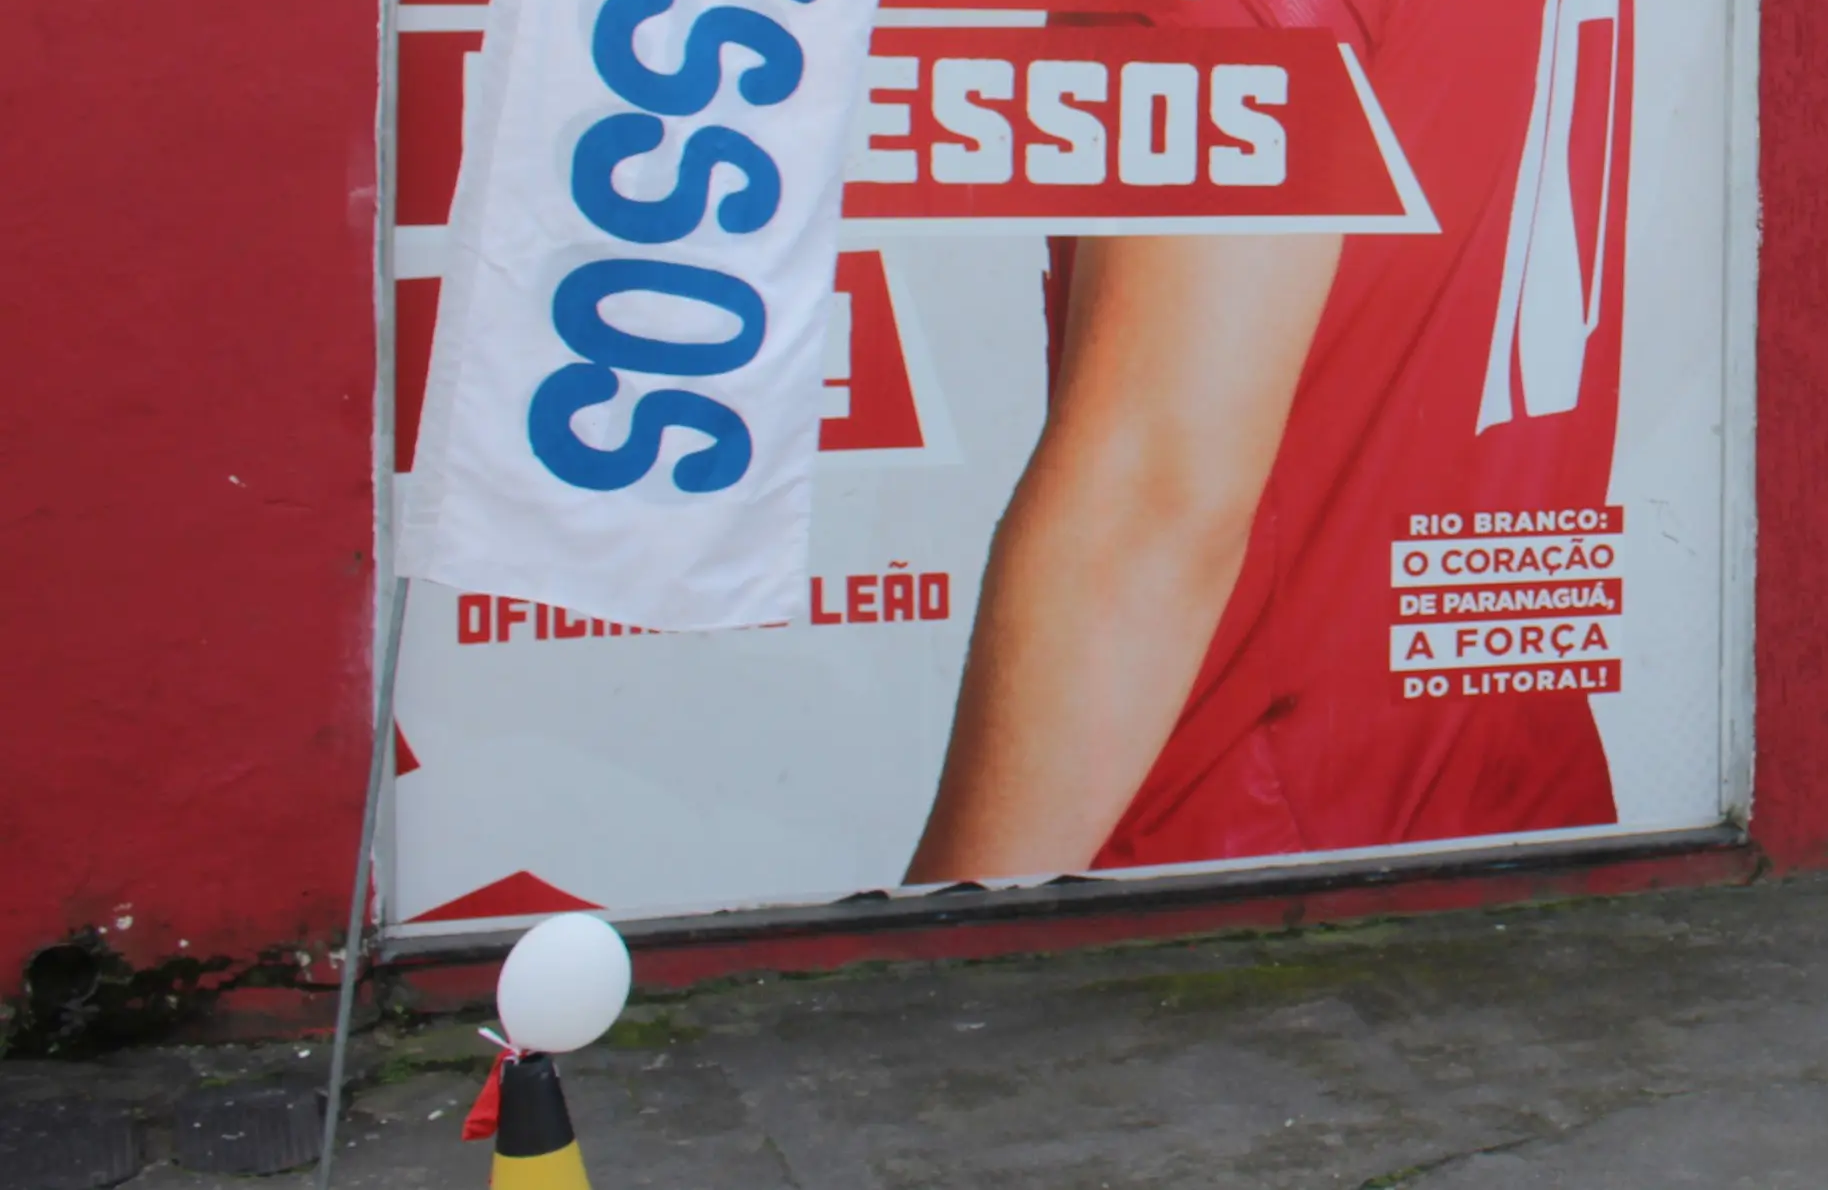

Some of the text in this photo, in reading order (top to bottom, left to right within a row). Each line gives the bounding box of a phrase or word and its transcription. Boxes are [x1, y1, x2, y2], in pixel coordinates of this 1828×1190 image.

[1409, 508, 1609, 536] RIO BRANCO:
[1402, 538, 1614, 576] O CORAÇÃO
[809, 562, 951, 626] LEÃO
[1400, 582, 1615, 615] DE PARANAGUÁ,
[1405, 623, 1609, 660] A FORÇA
[1403, 667, 1608, 699] DO LITORAL!
